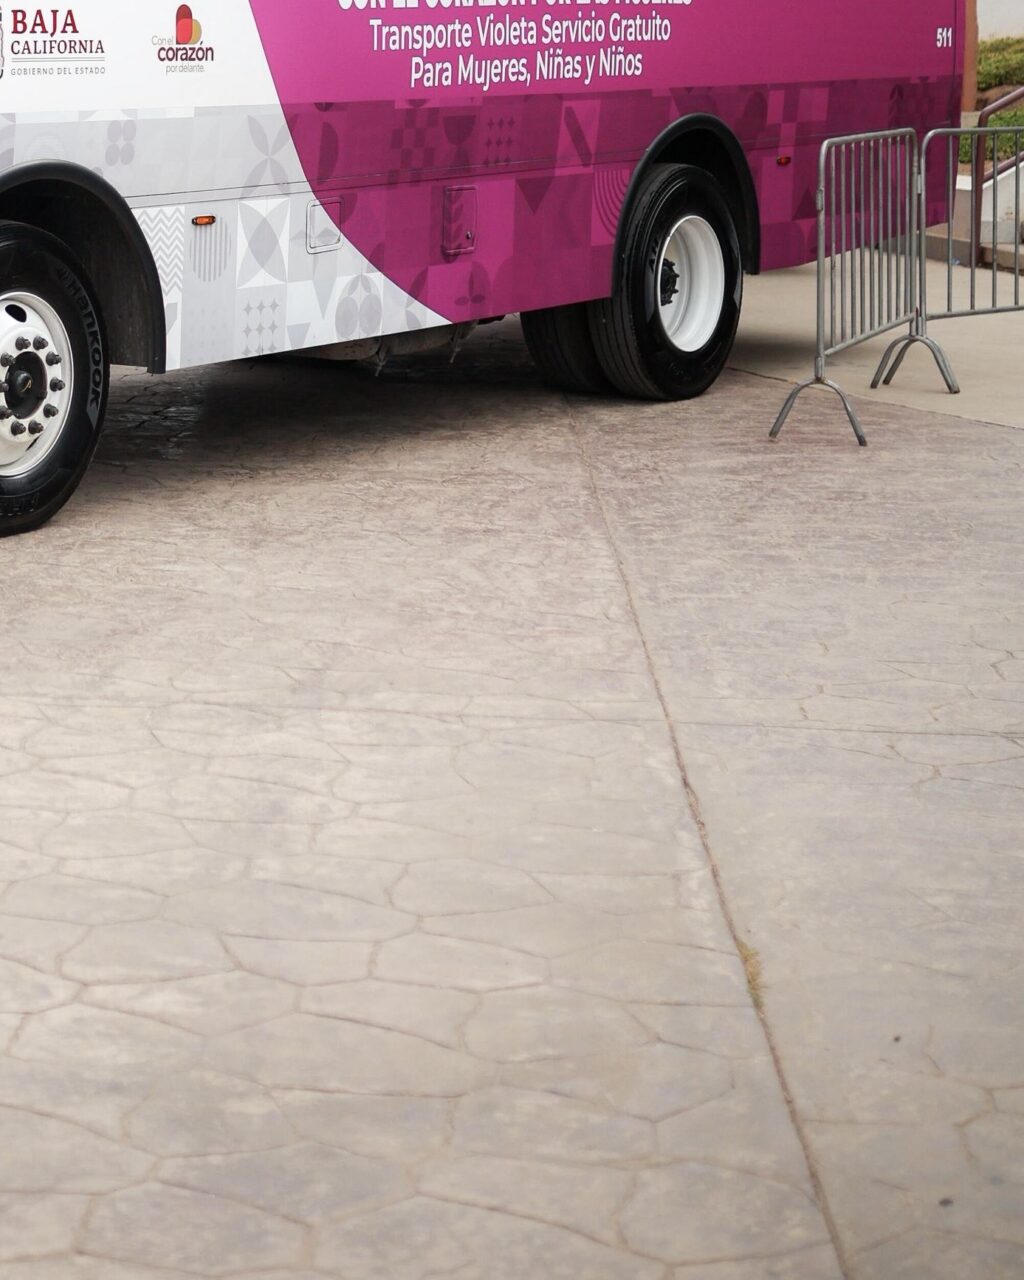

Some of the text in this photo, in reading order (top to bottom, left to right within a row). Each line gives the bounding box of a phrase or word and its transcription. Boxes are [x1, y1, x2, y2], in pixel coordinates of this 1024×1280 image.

[11, 9, 79, 37] BAJA
[369, 10, 671, 57] Transporte Violeta Servicio Gratuito
[11, 39, 105, 55] CALIFORNIA
[151, 35, 166, 46] Con
[936, 27, 952, 48] 511
[157, 40, 214, 62] corazón
[10, 66, 106, 76] GOBIERNO DEL ESTADO
[166, 65, 177, 76] por
[411, 45, 642, 91] Para Mujeres, Niñas y Niños
